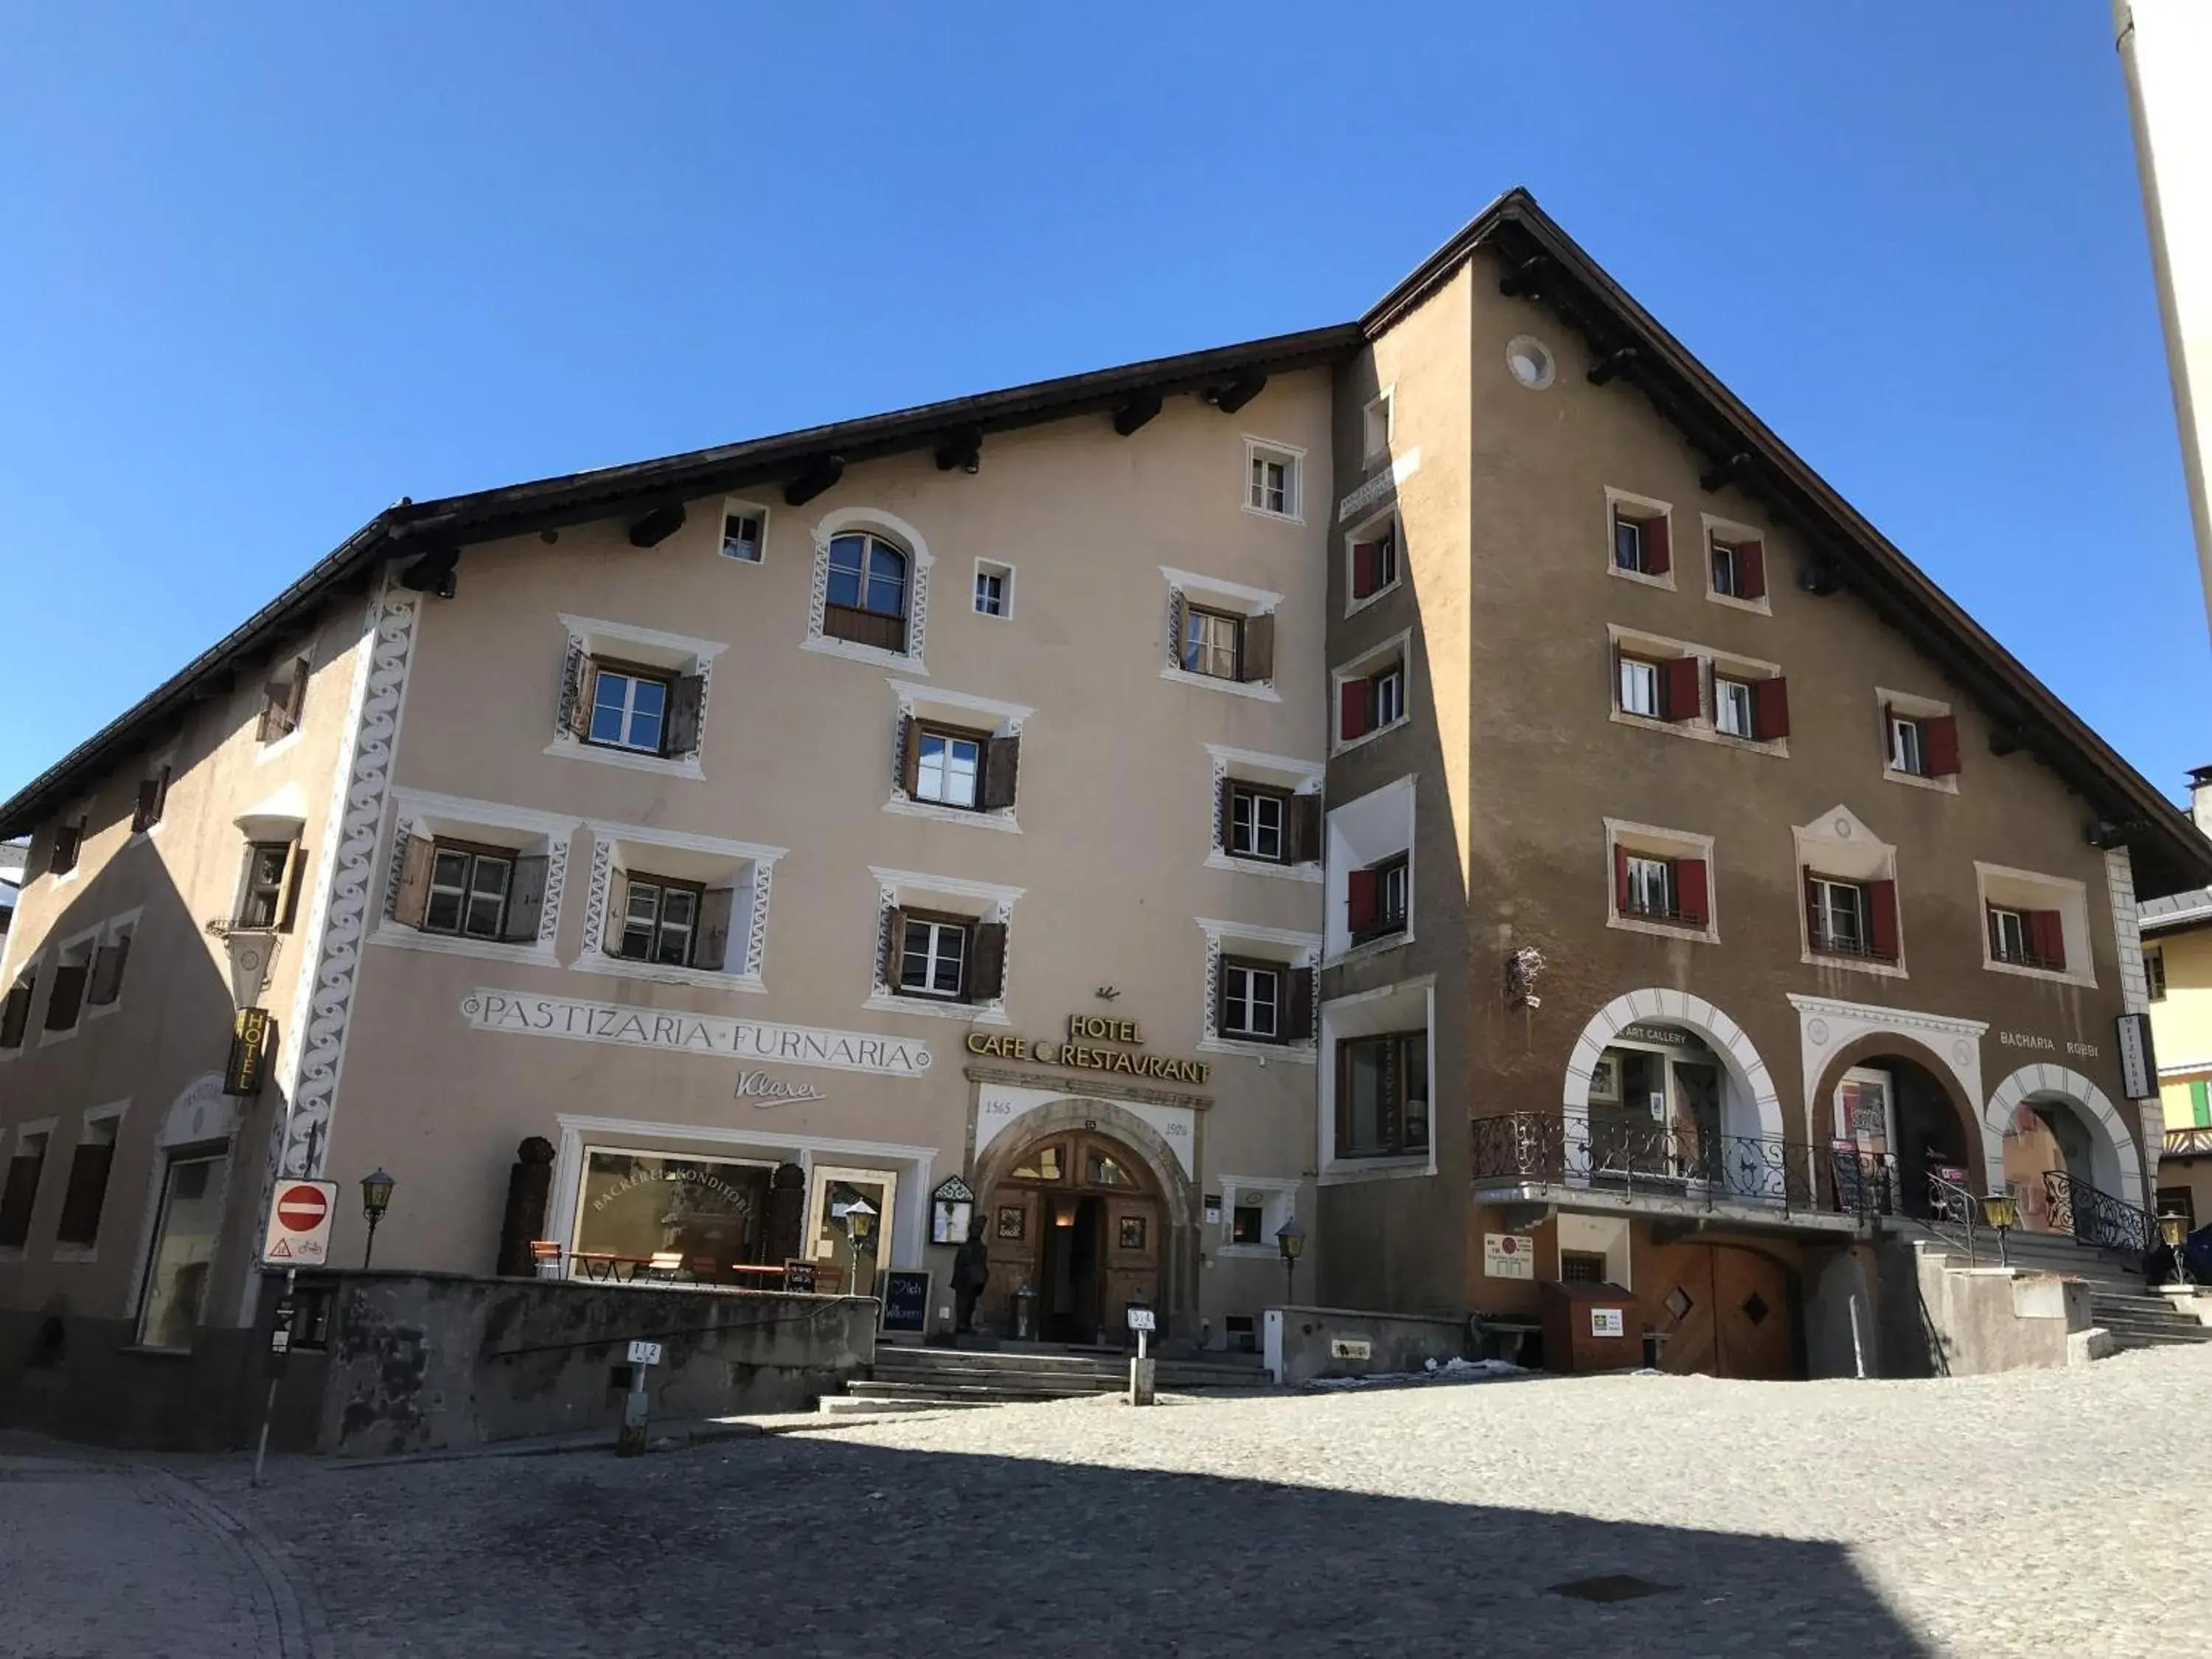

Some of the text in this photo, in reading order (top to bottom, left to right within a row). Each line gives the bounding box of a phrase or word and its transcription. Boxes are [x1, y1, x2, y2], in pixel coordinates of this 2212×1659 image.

[484, 995, 914, 1069] PASTIZARIA FURNARIA
[1070, 1014, 1144, 1043] HOTEL
[1627, 1026, 1644, 1039] ART
[1646, 1030, 1686, 1044] GALLERY
[240, 1014, 262, 1089] HOTEL
[967, 1032, 1027, 1058] CAFE
[2000, 1032, 2099, 1057] BACHARIA ROBBI
[734, 1069, 821, 1103] Klarer
